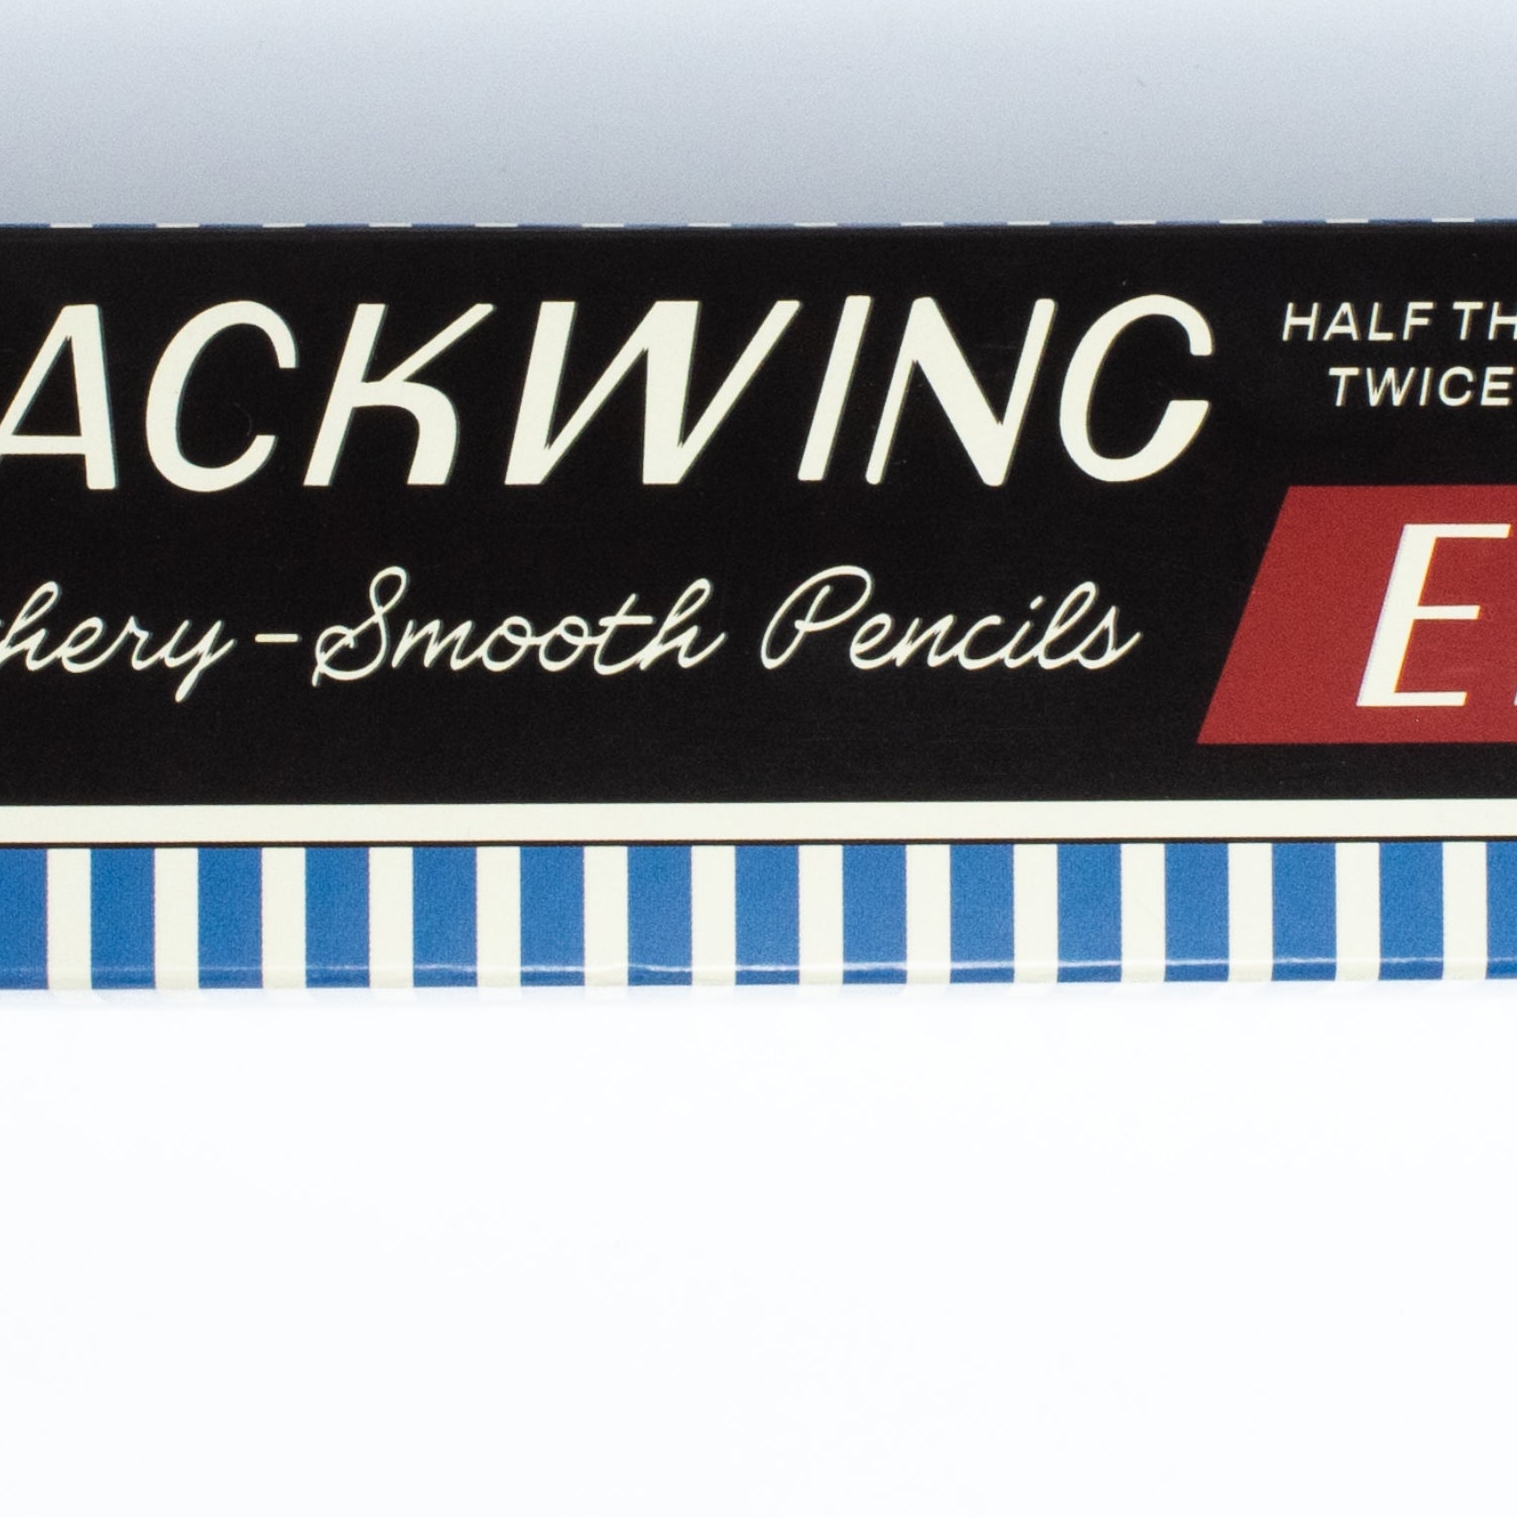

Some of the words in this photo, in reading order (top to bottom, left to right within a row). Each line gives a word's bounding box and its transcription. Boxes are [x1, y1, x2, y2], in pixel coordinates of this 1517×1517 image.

[1282, 301, 1434, 342] HALF
[1327, 366, 1516, 408] TWICE
[759, 565, 1144, 672] Pencils
